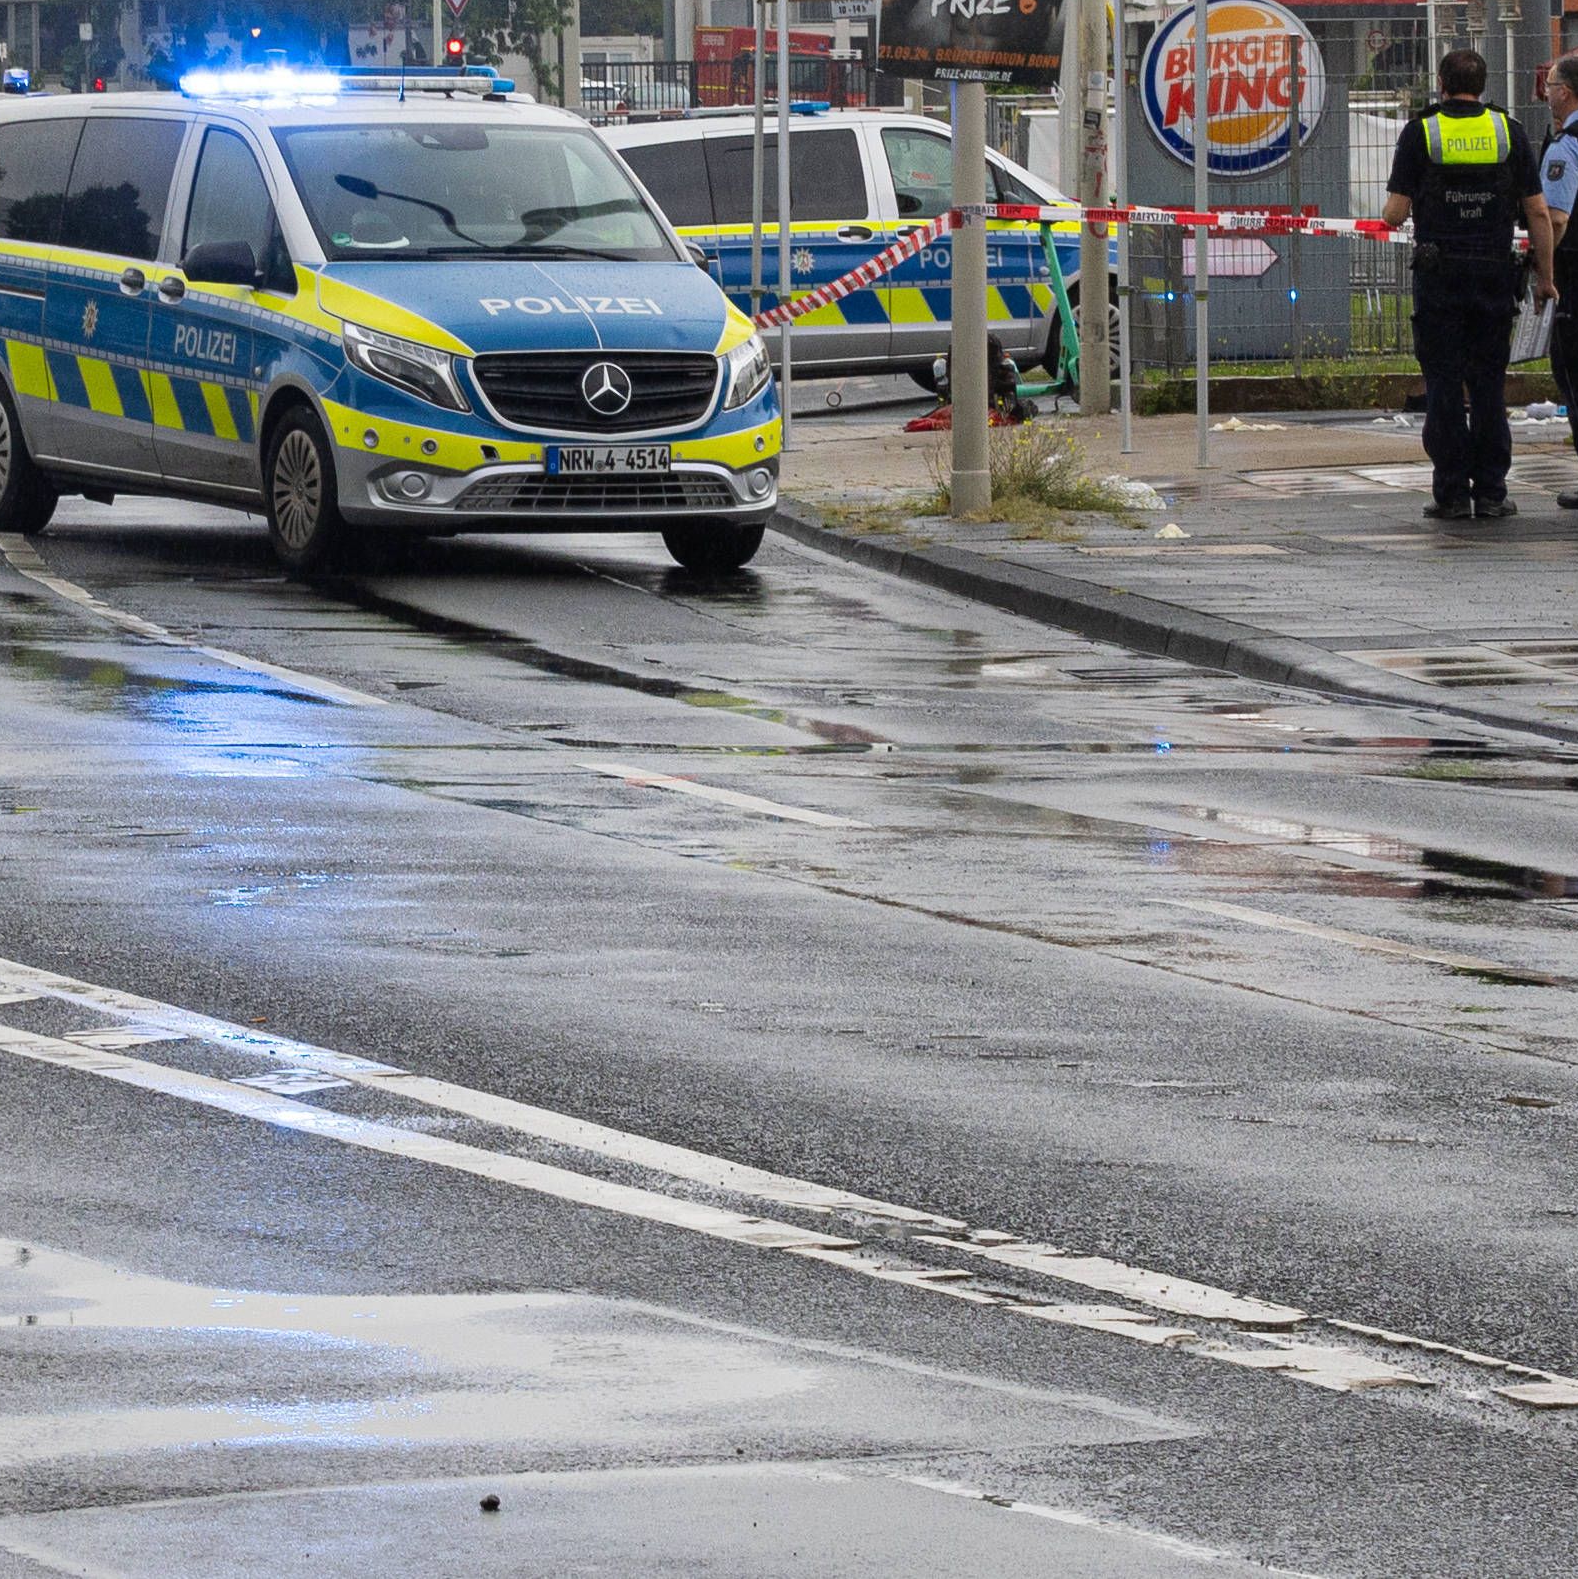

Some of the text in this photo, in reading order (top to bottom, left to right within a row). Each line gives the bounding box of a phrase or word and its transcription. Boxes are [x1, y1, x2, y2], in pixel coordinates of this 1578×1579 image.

[1028, 53, 1060, 68] BONN
[1447, 136, 1493, 153] POLIZEI
[1445, 189, 1496, 204] Führungs-
[1460, 206, 1483, 219] kraft
[479, 296, 664, 317] POLIZEI
[174, 324, 237, 365] POLIZEI
[560, 449, 595, 471] NRW
[604, 448, 668, 470] 4-4514
